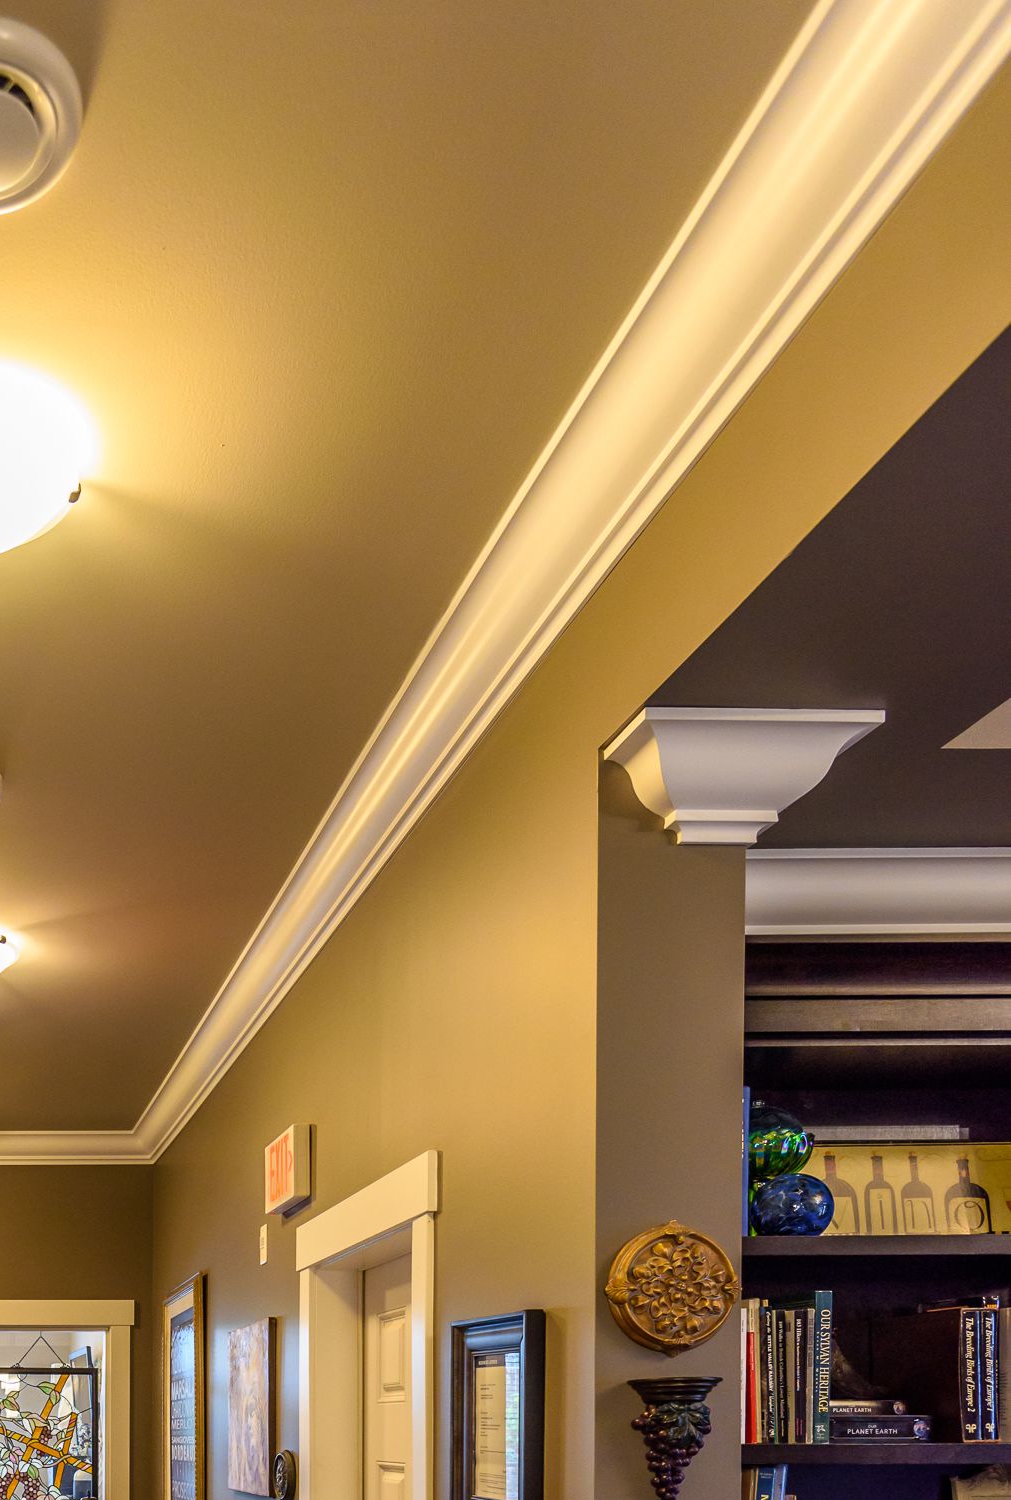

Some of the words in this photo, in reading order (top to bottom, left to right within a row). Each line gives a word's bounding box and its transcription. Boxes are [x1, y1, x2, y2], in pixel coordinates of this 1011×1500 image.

[269, 1133, 289, 1202] EXIT
[820, 1309, 831, 1330] OUR
[965, 1317, 974, 1330] The
[819, 1332, 830, 1365] SYLVAN
[965, 1330, 974, 1359] Breeding
[985, 1330, 993, 1358] Breeding
[818, 1367, 829, 1413] HERITAGE
[965, 1376, 975, 1385] of
[985, 1376, 993, 1384] of
[966, 1384, 975, 1407] Europe
